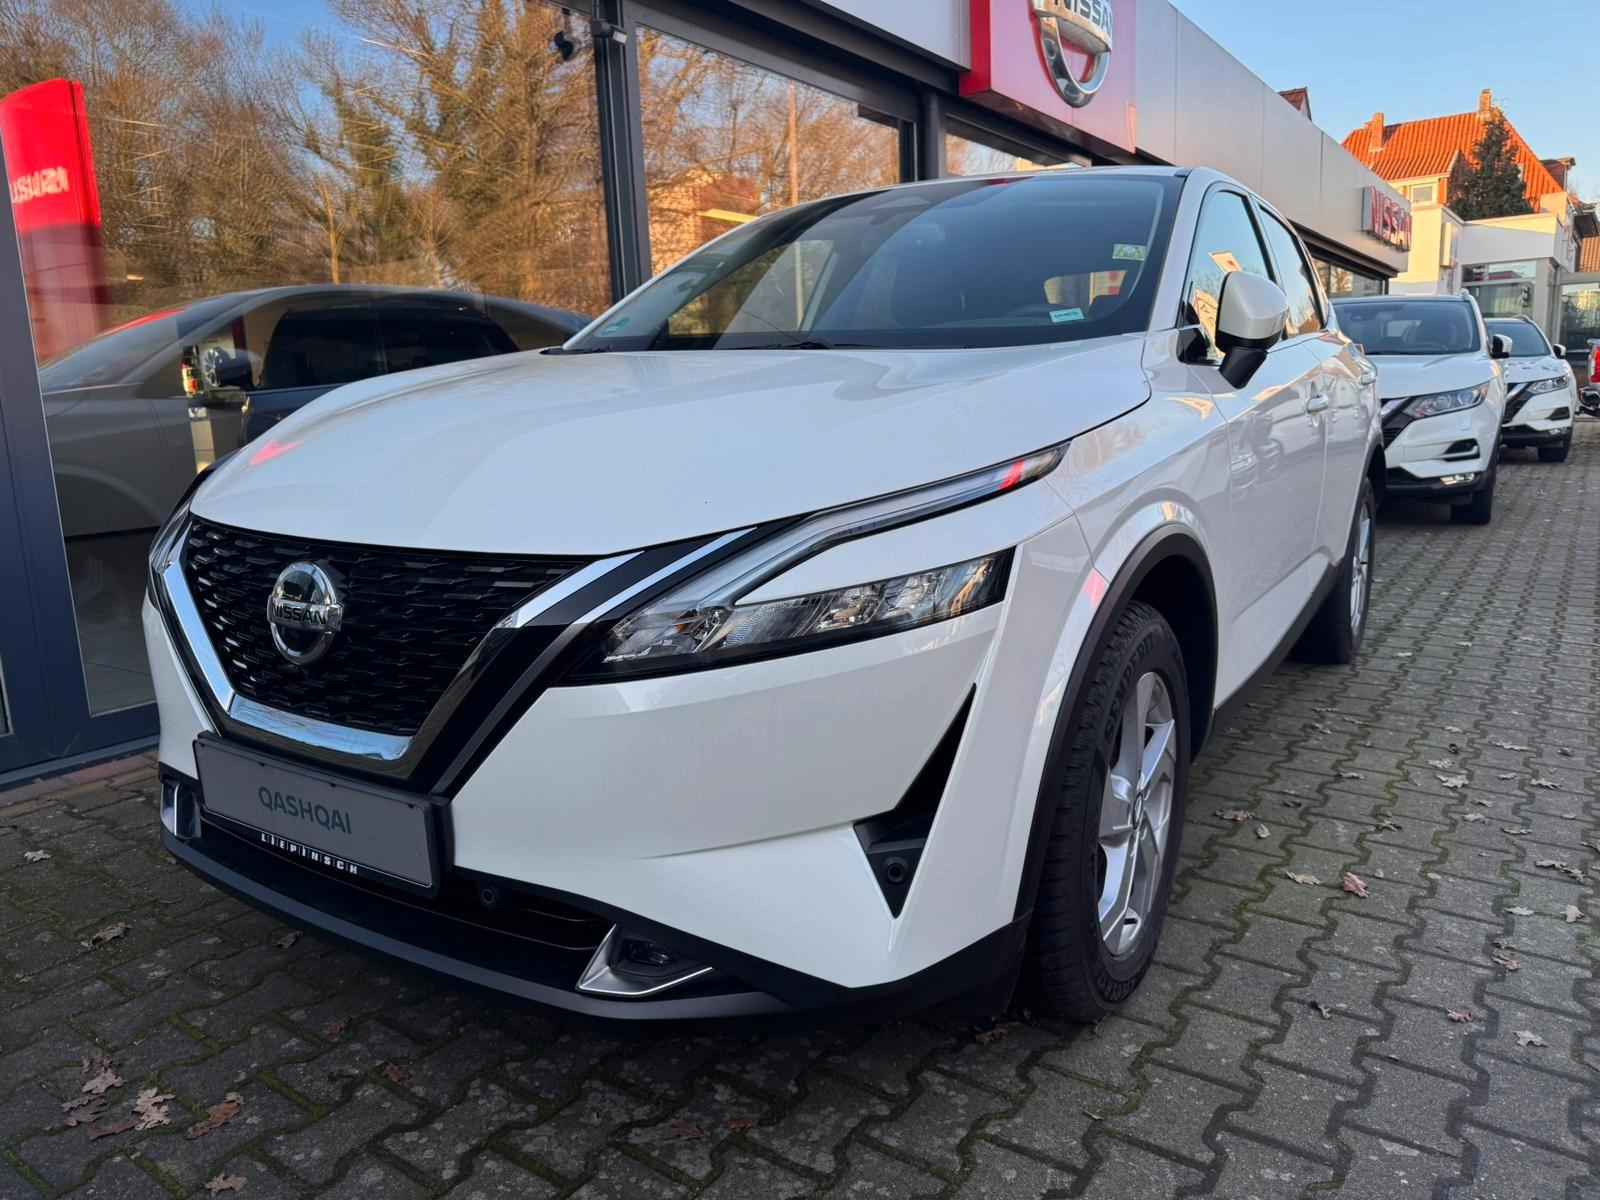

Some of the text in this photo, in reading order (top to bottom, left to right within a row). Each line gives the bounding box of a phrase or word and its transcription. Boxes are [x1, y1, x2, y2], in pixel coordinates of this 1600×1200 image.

[272, 604, 327, 625] NISSAN
[258, 786, 351, 835] QASHQAI
[261, 833, 358, 875] LIEPINSCH
